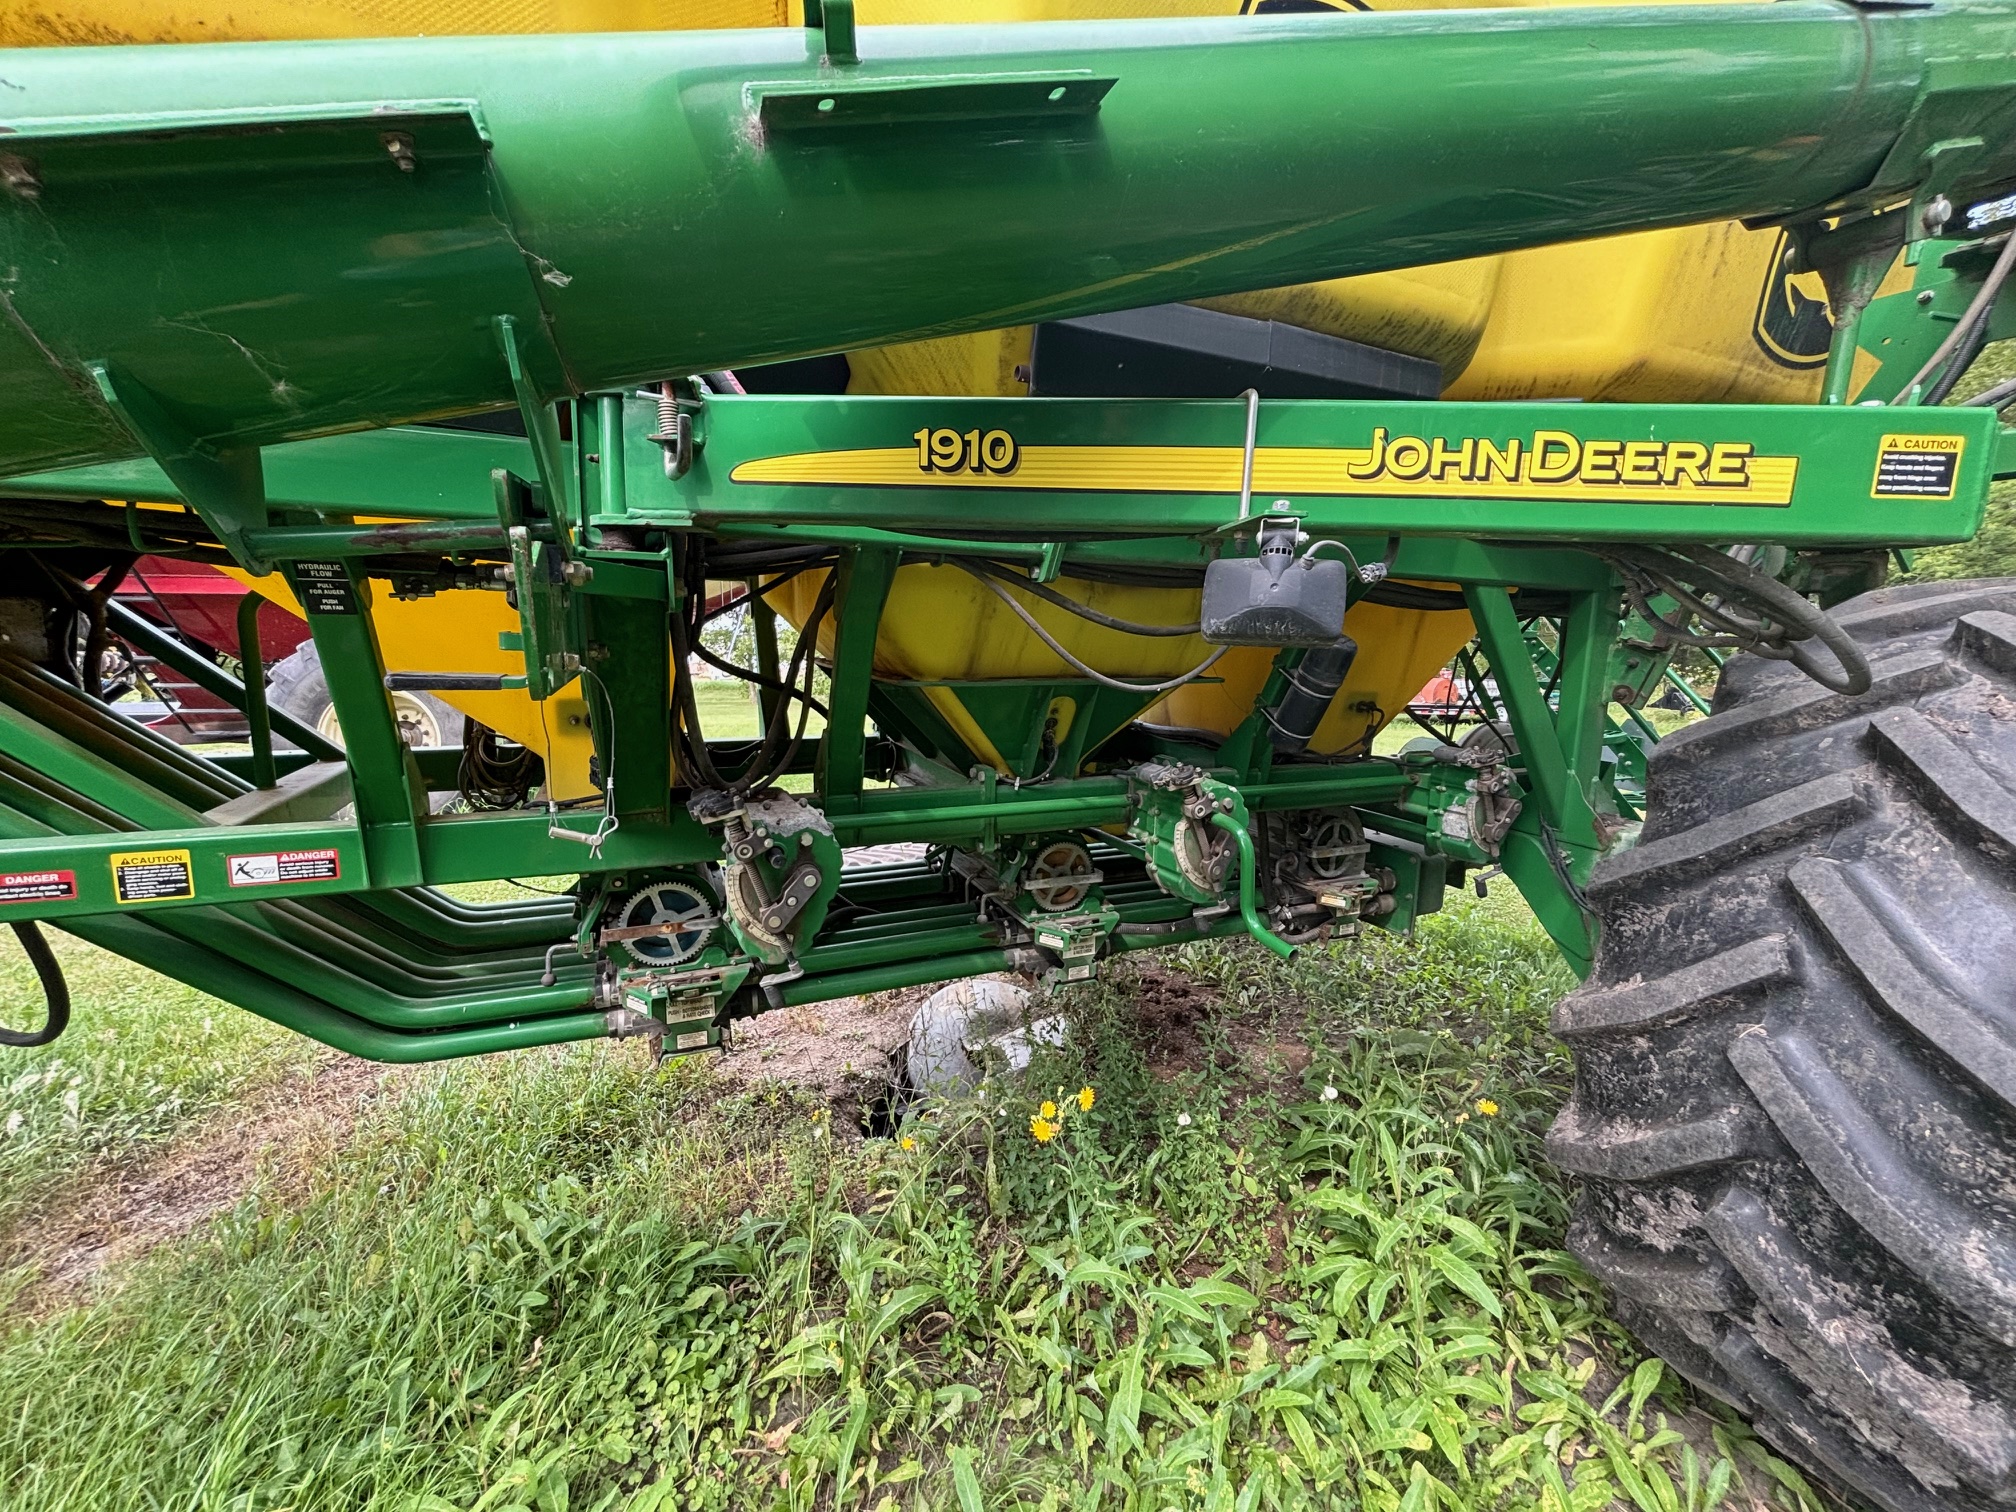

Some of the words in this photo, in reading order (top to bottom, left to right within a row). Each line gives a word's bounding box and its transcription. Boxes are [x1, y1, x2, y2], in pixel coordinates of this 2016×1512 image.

[1904, 439, 1958, 449] CAUTION
[913, 427, 1018, 474] 1910
[1347, 427, 1522, 483] JOHN
[1529, 430, 1754, 486] DEERE
[297, 563, 341, 571] HYDRAULIC
[131, 855, 183, 865] CAUTION
[289, 850, 335, 860] DANGER
[5, 873, 59, 884] DANGER
